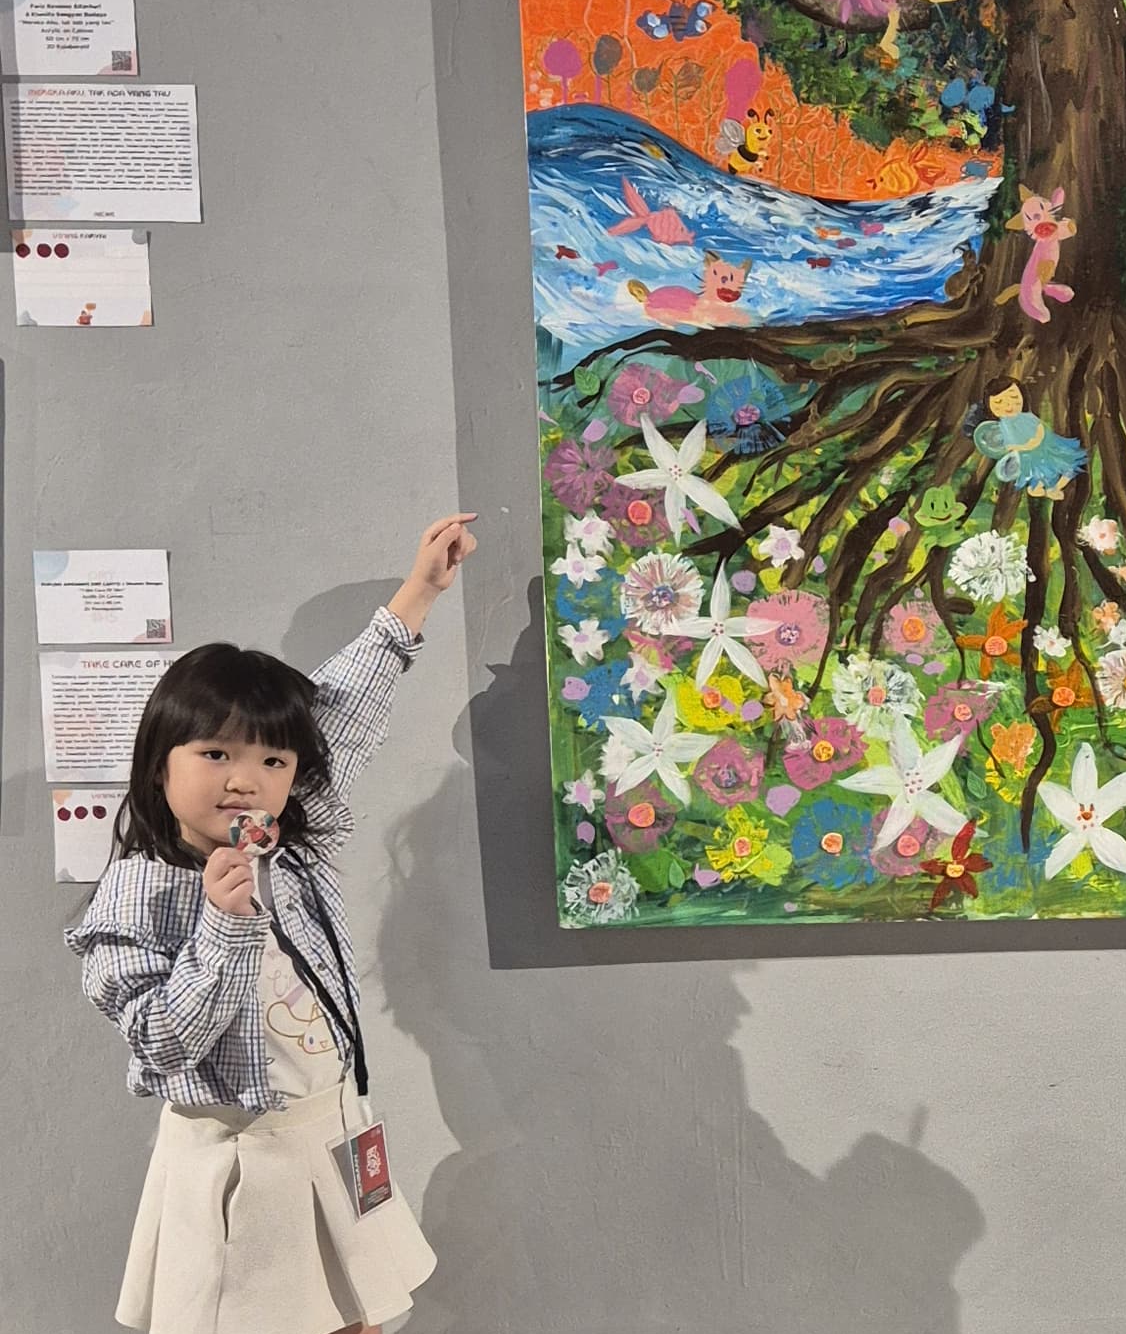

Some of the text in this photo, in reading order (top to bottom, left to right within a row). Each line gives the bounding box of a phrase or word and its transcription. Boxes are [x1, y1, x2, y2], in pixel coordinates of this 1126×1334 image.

[81, 660, 110, 669] TAKE
[112, 660, 142, 668] CARE
[145, 660, 161, 668] OF
